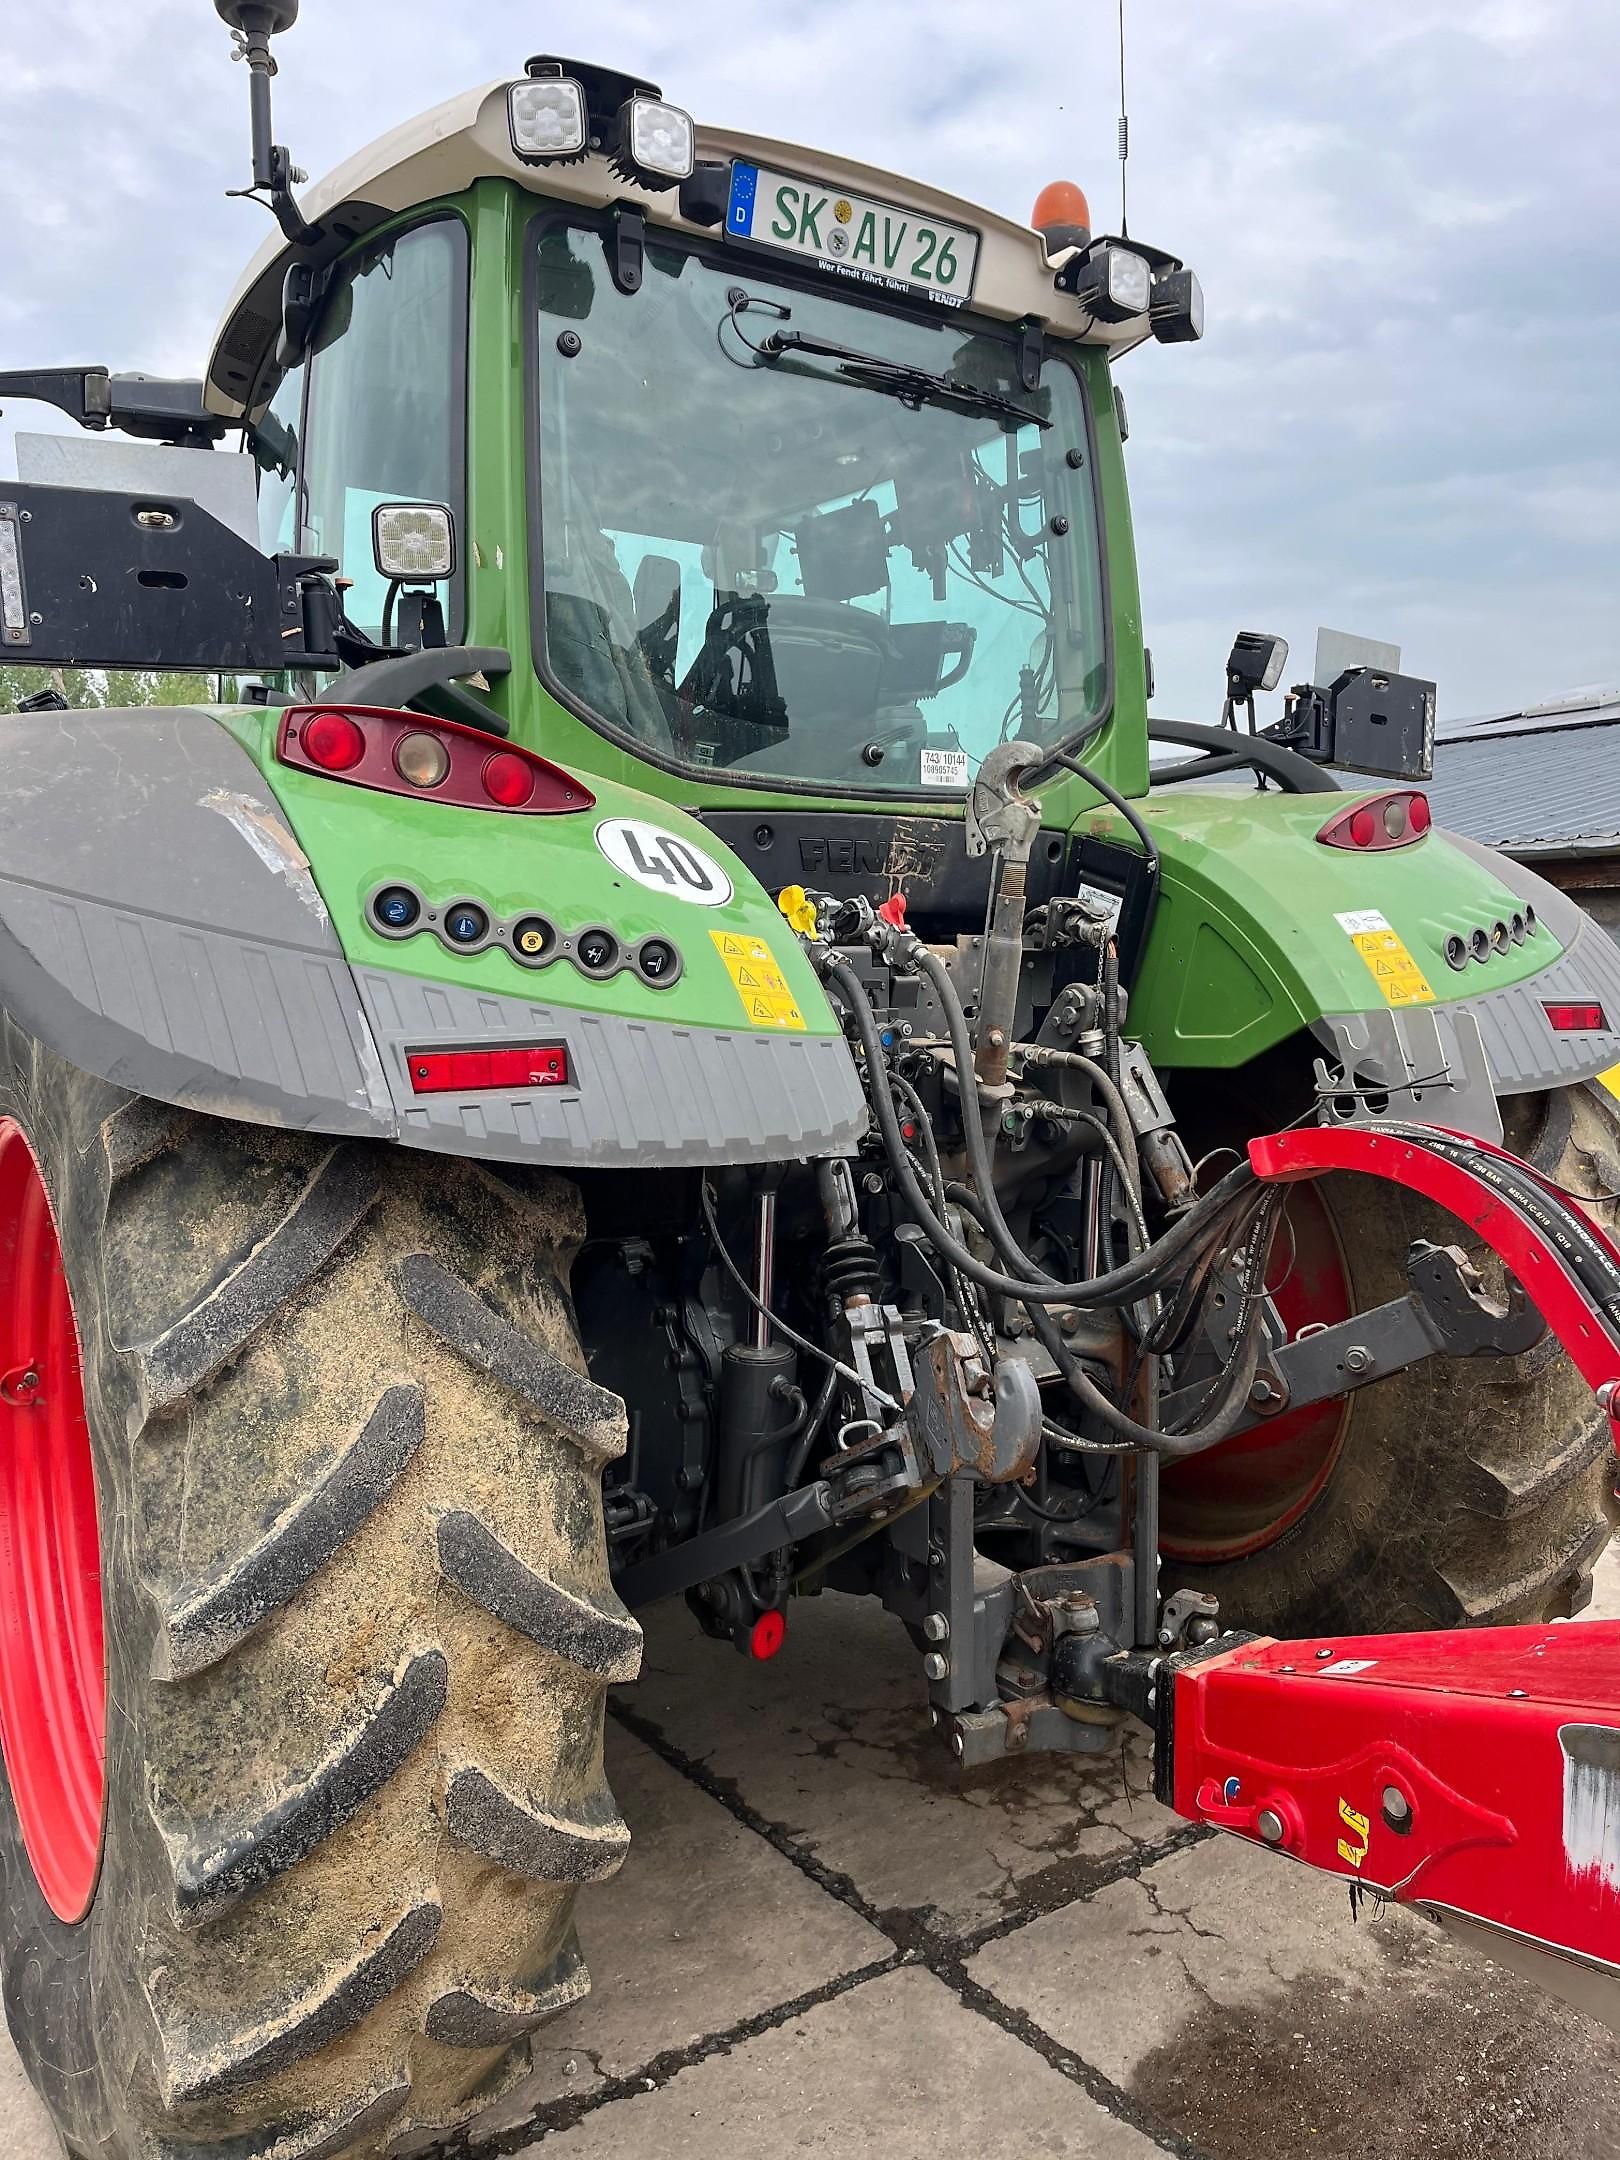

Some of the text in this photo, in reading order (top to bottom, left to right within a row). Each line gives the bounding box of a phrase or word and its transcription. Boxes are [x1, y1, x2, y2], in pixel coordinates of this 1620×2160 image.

[736, 206, 746, 223] D
[772, 186, 957, 284] SK AV 26
[818, 259, 836, 273] Wer
[836, 265, 861, 279] Fendt
[886, 278, 910, 293] führt!
[928, 290, 964, 308] FENDT
[620, 829, 713, 891] 40
[1560, 1210, 1619, 1278] HANSA-FLEX
